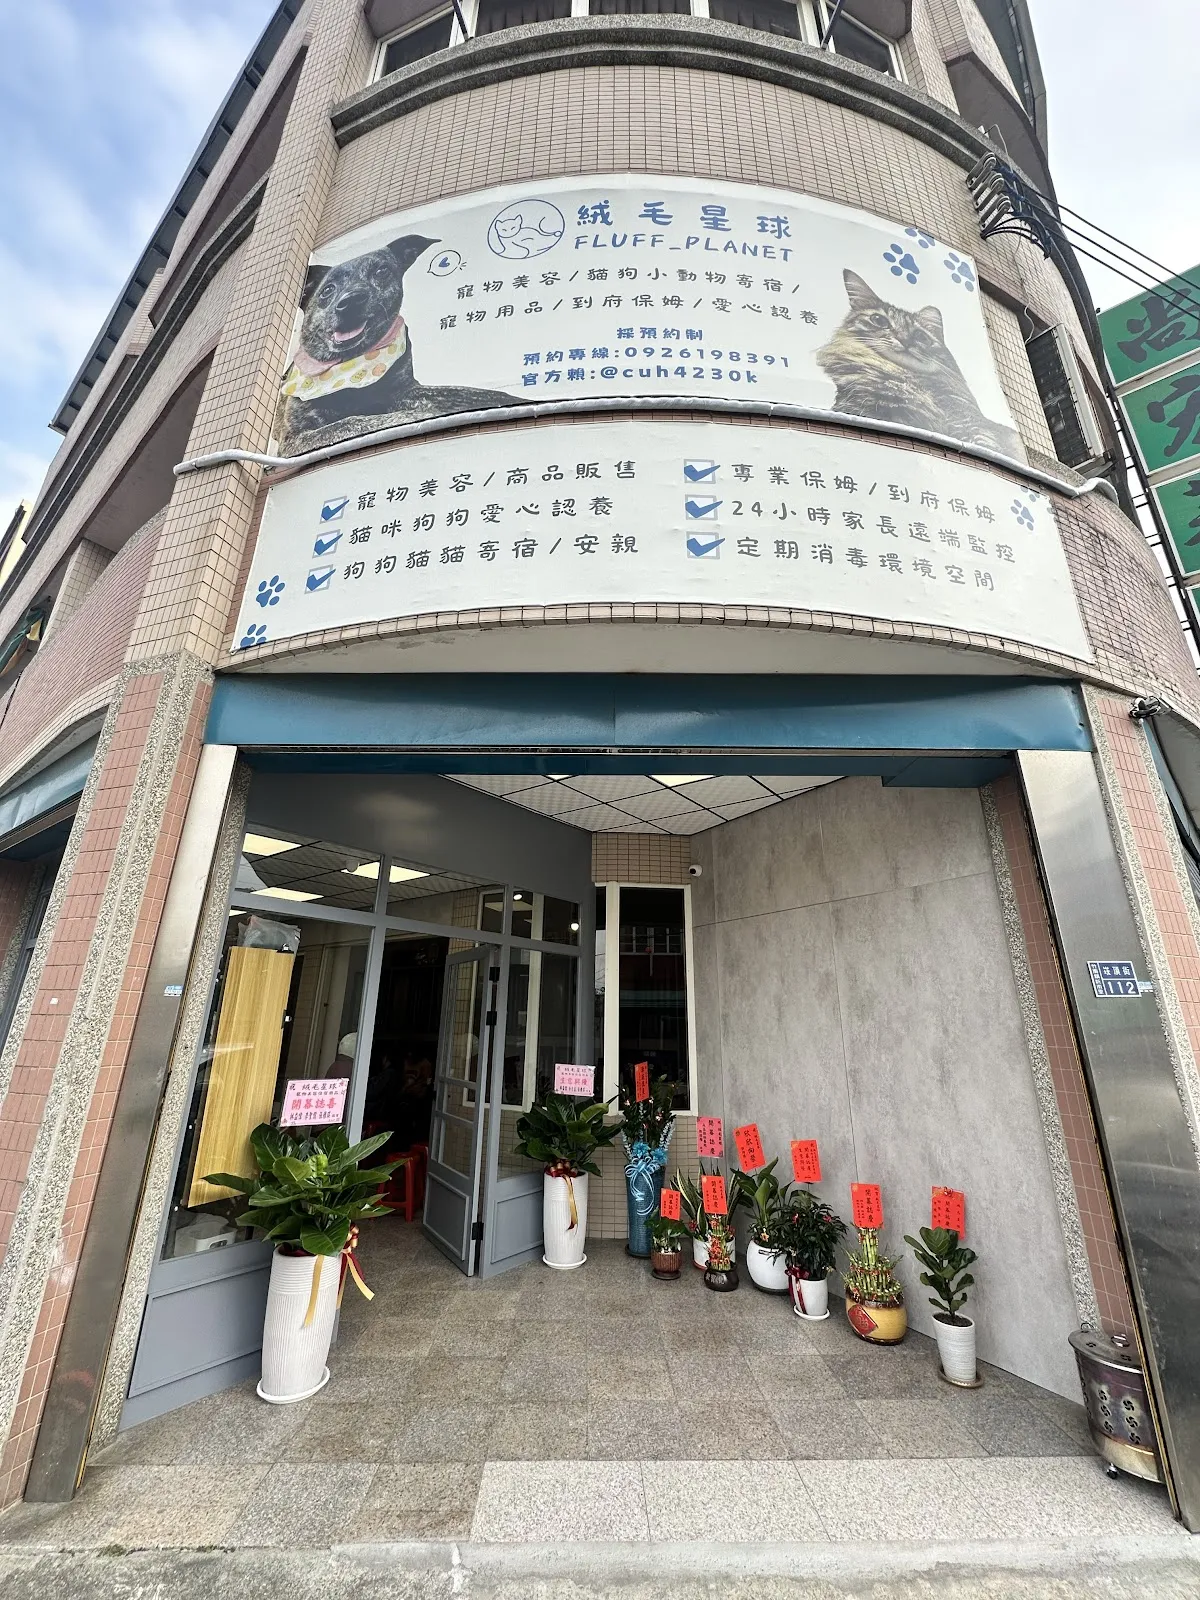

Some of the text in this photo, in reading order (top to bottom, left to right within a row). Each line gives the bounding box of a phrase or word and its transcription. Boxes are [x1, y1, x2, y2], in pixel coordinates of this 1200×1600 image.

[576, 200, 792, 239] 絨毛星球
[574, 232, 793, 262] FLUFF_PLANET
[456, 267, 801, 300] 寵物美容/貓狗小動物寄宿/
[439, 294, 819, 330] 寵物用品/到府保姆/愛心認養
[616, 327, 703, 341] 採預約制
[357, 459, 638, 511] 寵物美容/商品販售
[730, 462, 997, 525] 專業保姆/到府保姆
[348, 495, 614, 546] 貓咪狗狗愛心認養
[731, 499, 1017, 565] 24小時家長遠端監控
[343, 533, 639, 581] 狗狗貓貓寄宿/安親
[736, 537, 996, 592] 定期消毒環境空間
[1107, 981, 1137, 994] 112
